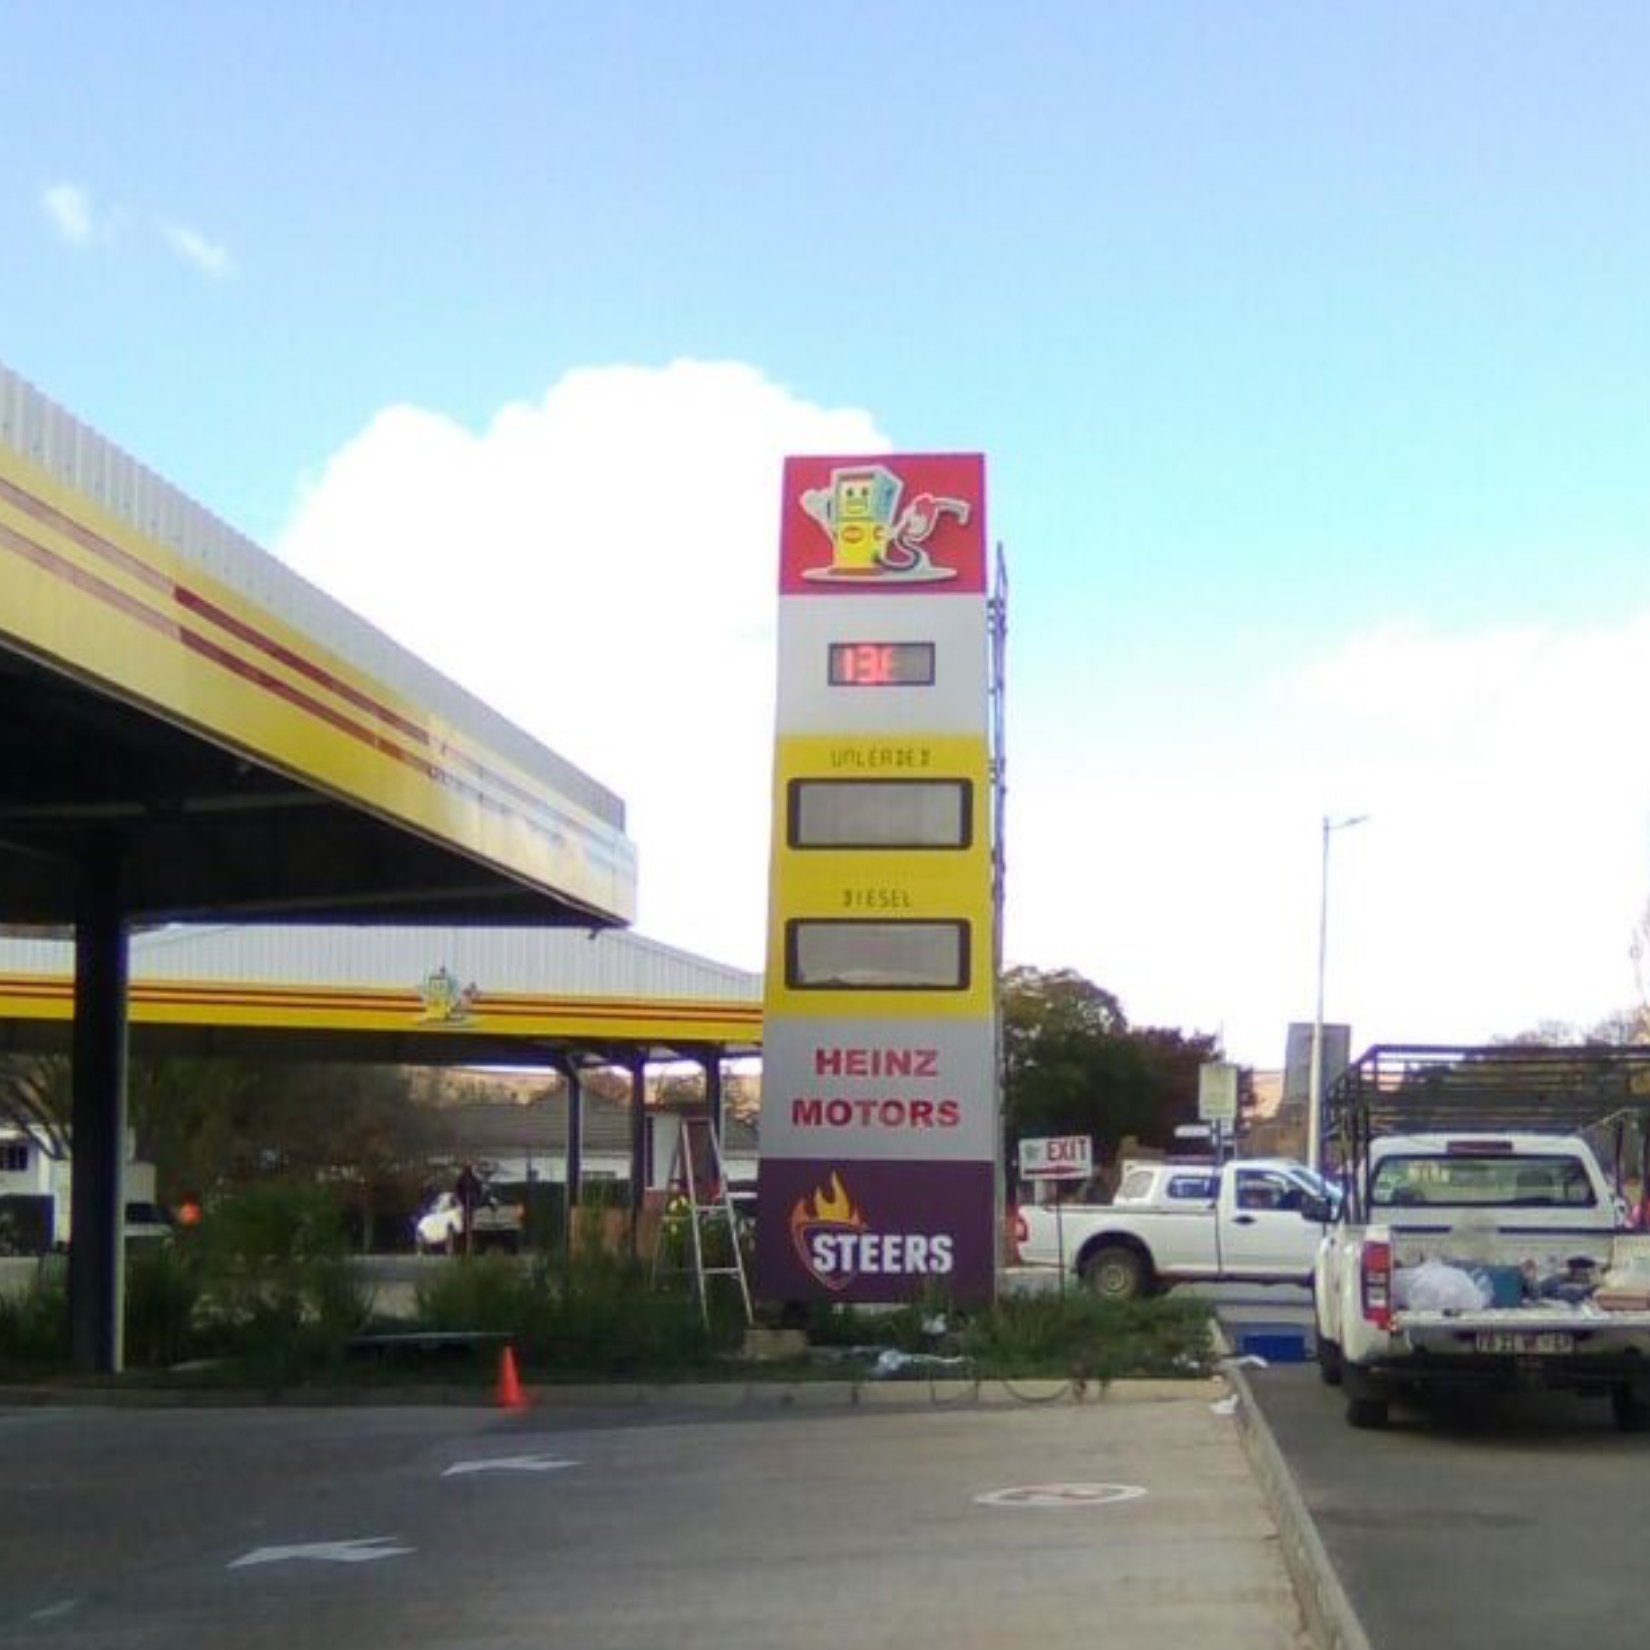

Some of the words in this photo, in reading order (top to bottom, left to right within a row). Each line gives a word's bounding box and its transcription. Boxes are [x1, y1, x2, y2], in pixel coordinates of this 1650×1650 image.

[842, 888, 911, 908] DIESEL
[815, 1048, 938, 1076] HEINZ
[792, 1098, 960, 1127] MOTORS
[1047, 1137, 1087, 1161] EXIT
[812, 1232, 953, 1275] STEERS
